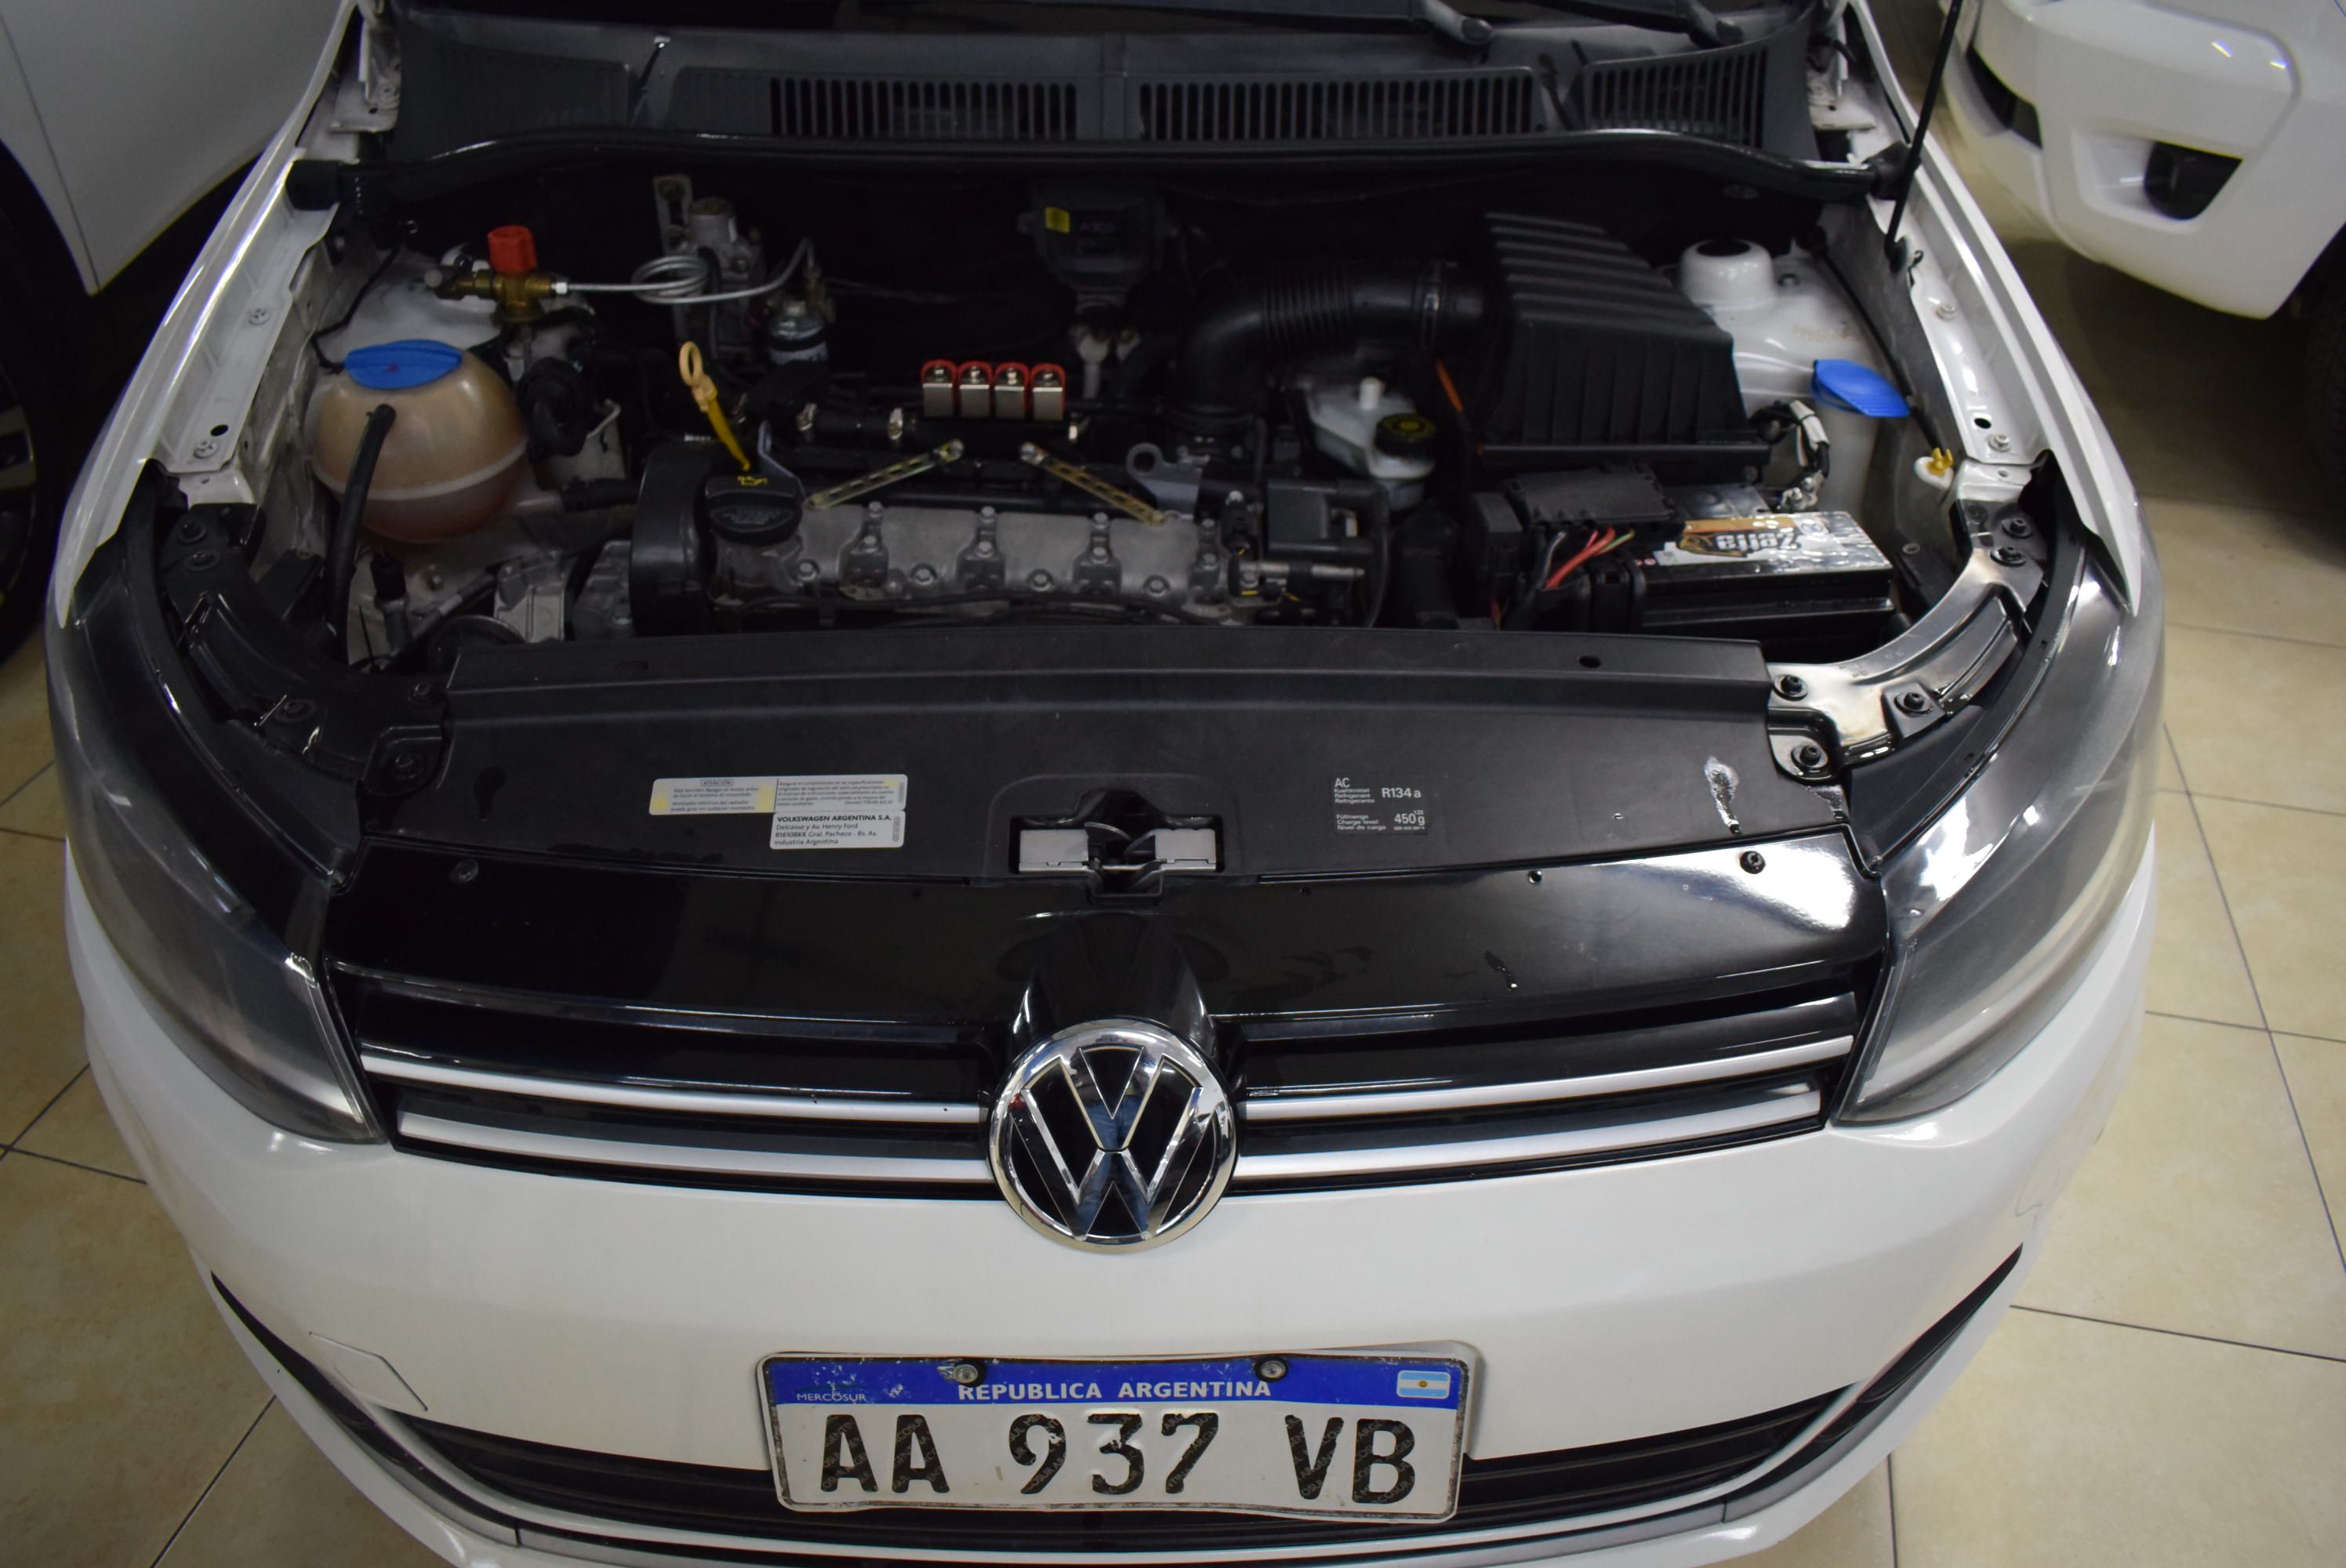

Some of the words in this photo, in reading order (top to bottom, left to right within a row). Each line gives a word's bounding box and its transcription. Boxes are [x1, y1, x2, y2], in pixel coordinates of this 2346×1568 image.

[1335, 777, 1350, 788] AC
[1393, 813, 1416, 824] 450
[805, 838, 839, 847] Argentina
[957, 1382, 1102, 1400] REPUBLICA
[1118, 1381, 1271, 1399] ARGENTINA
[796, 1392, 866, 1402] MERCOSUR
[820, 1413, 952, 1494] AA
[1008, 1412, 1220, 1496] 937
[1284, 1414, 1417, 1504] VB
